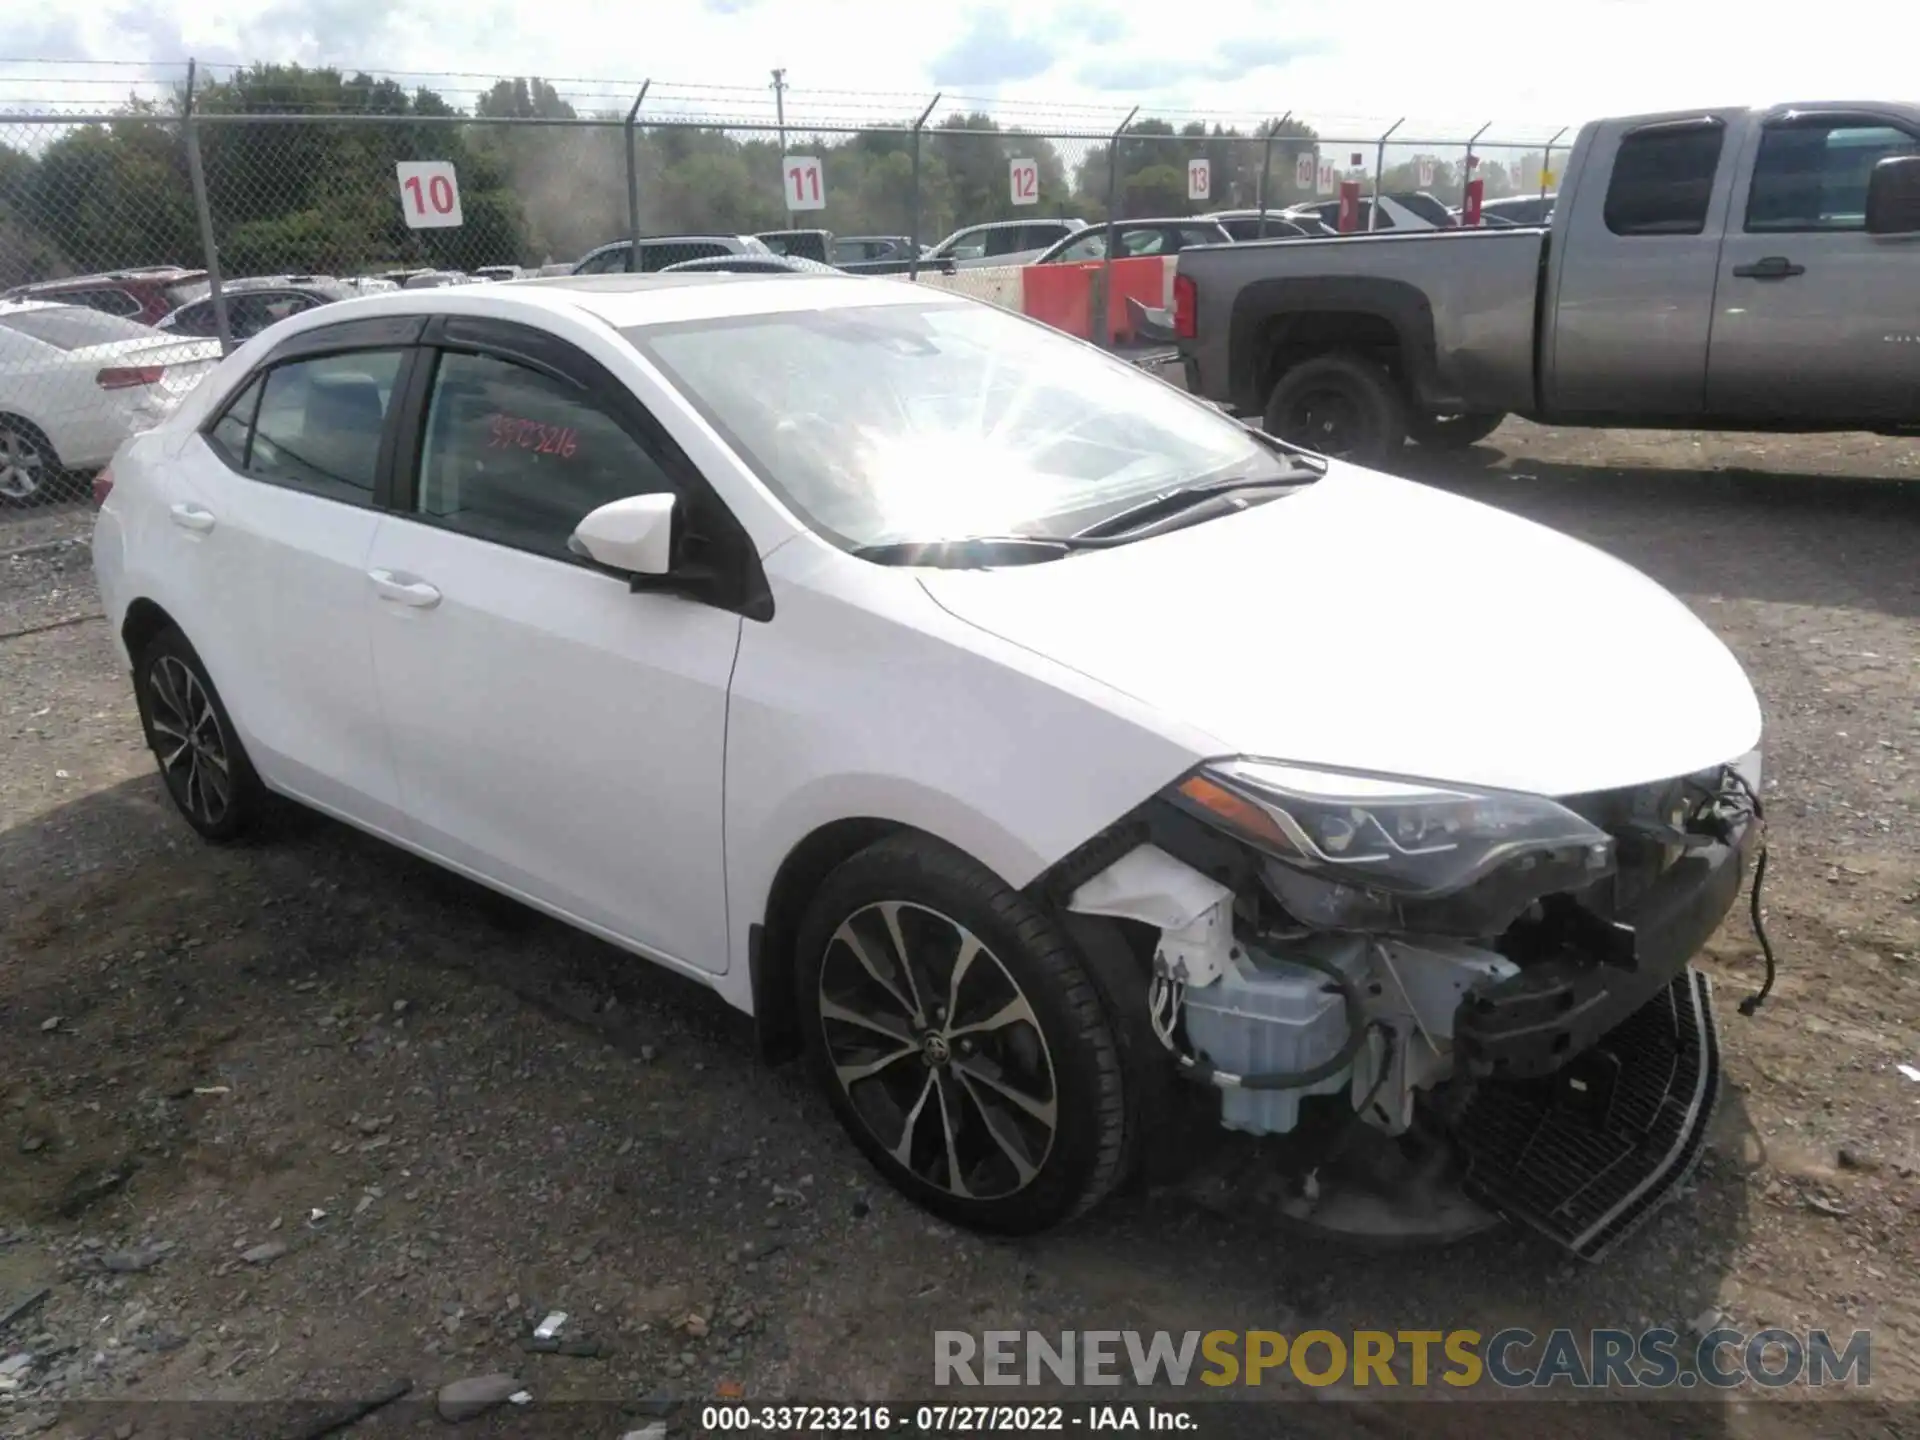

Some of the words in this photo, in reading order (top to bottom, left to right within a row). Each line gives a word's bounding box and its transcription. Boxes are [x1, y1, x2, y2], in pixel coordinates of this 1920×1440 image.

[405, 175, 454, 214] 10
[789, 167, 819, 201] 11
[1014, 167, 1036, 197] 12
[1191, 167, 1208, 193] 13
